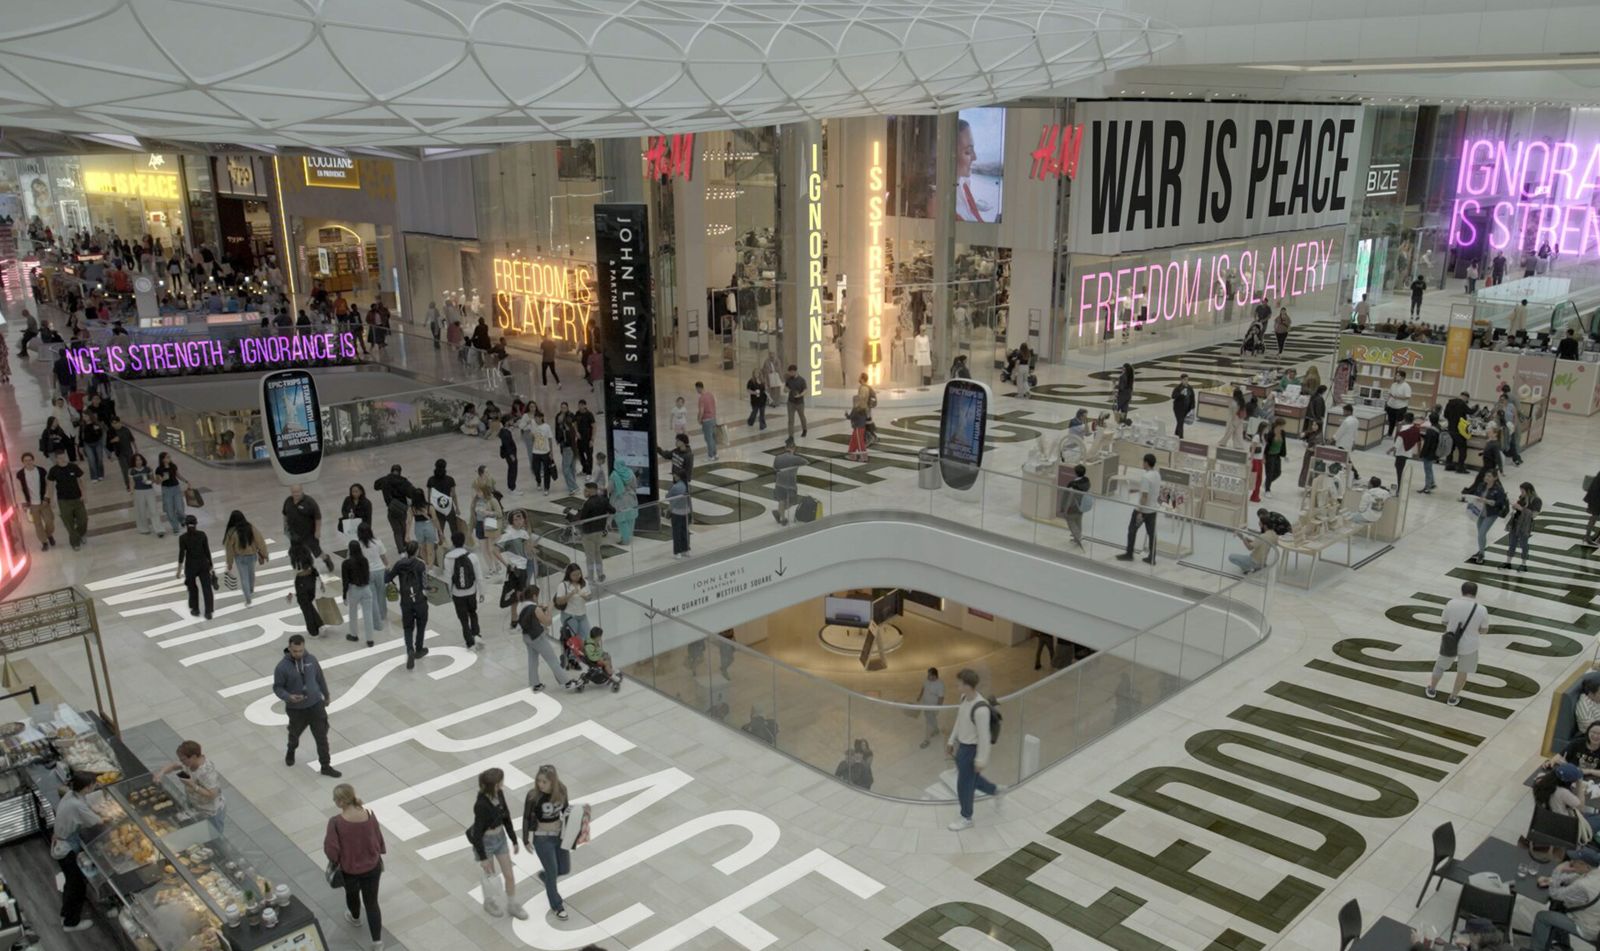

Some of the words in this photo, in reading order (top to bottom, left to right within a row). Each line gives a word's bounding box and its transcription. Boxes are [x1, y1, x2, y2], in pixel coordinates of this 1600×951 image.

[869, 141, 882, 192] IS
[1029, 123, 1086, 181] H&M
[1091, 119, 1187, 235] WAR
[1198, 118, 1237, 225] IS
[1246, 117, 1355, 220] PEACE
[128, 173, 181, 199] PEACE
[1366, 169, 1400, 192] BIZE
[616, 217, 634, 280] JOHN
[1448, 198, 1480, 247] IS
[494, 258, 569, 300] FREEDOM
[575, 269, 591, 302] IS
[610, 270, 619, 321] PARTNERS
[808, 143, 823, 397] IGNORANCE
[867, 196, 883, 386] STRENGTH
[1078, 258, 1202, 337] FREEDOM
[1208, 253, 1231, 313] IS
[1236, 238, 1334, 307] SLAVERY
[497, 290, 592, 345] SLAVERY
[622, 292, 638, 362] LEWIS
[65, 346, 104, 375] NCE
[106, 345, 126, 372] IS
[128, 340, 225, 372] STRENGTH
[239, 333, 336, 364] IGNORANCE
[339, 332, 356, 358] IS
[682, 595, 709, 611] QUARTER
[716, 583, 748, 599] WESTFIELD
[751, 574, 772, 588] SQUARE
[692, 576, 716, 590] JOHN
[719, 566, 745, 581] LEWIS
[216, 629, 478, 727] IS
[1303, 637, 1541, 720] IS
[307, 687, 886, 951] PEACE
